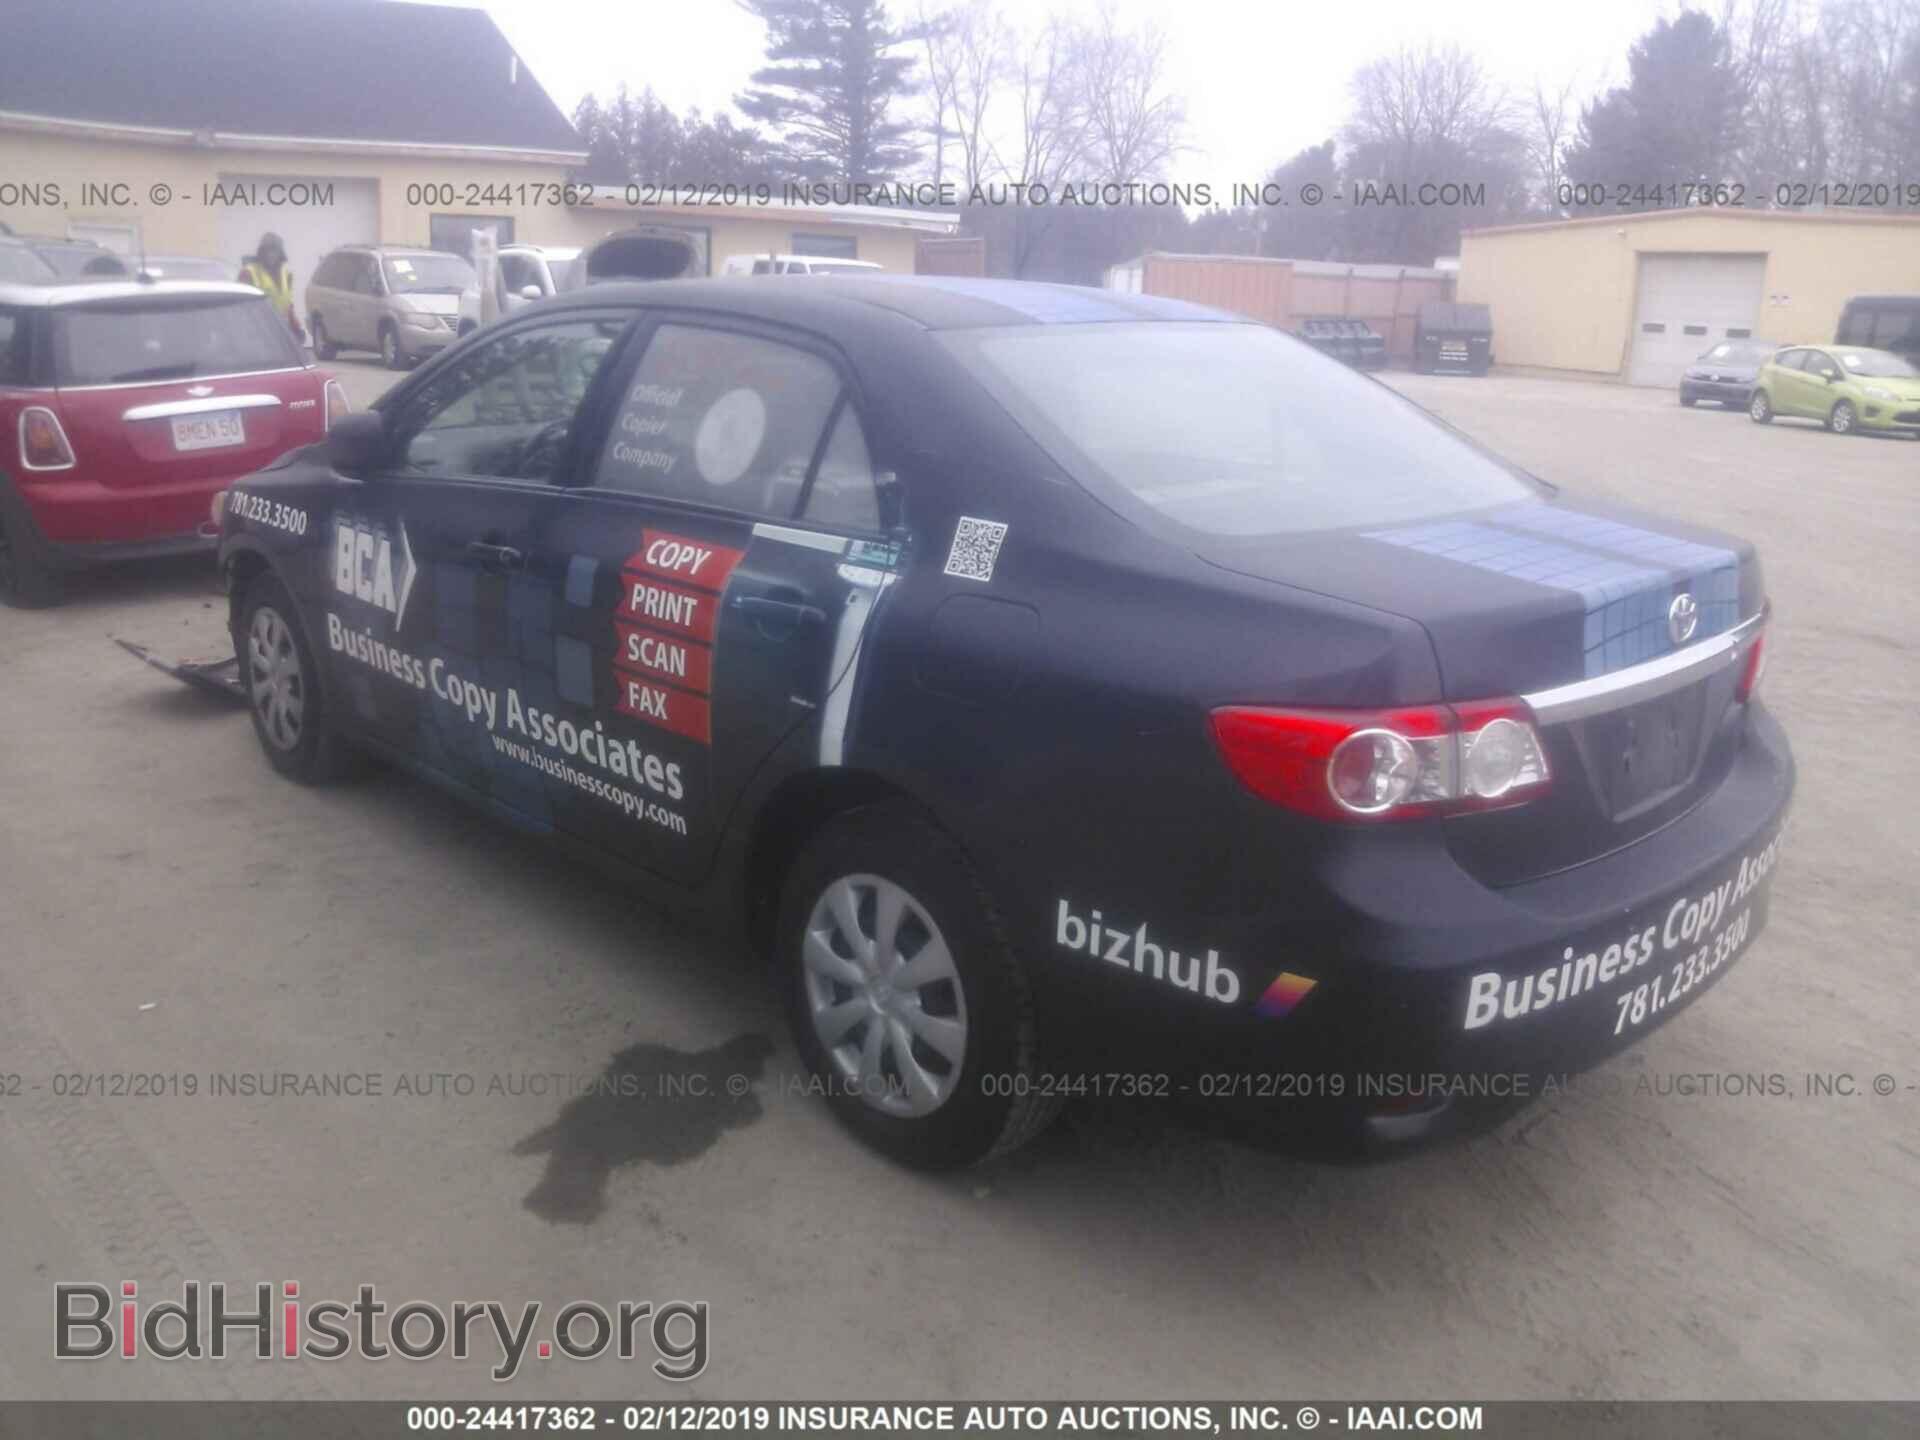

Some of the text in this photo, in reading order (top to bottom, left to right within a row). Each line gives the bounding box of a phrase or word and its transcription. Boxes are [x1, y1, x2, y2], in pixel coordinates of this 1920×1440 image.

[613, 441, 678, 475] Company
[230, 490, 308, 536] 781.233.3500
[336, 524, 397, 614] BCA
[646, 539, 712, 575] COPY
[631, 583, 698, 627] PRINT
[627, 633, 686, 677] SCAN
[327, 612, 685, 802] Business Copy Associates
[628, 682, 668, 720] FAX
[492, 735, 688, 836] www.businesscopy.com
[1056, 899, 1241, 1004] bizhub
[1464, 923, 1656, 1030] Business
[1663, 879, 1732, 950] Copy
